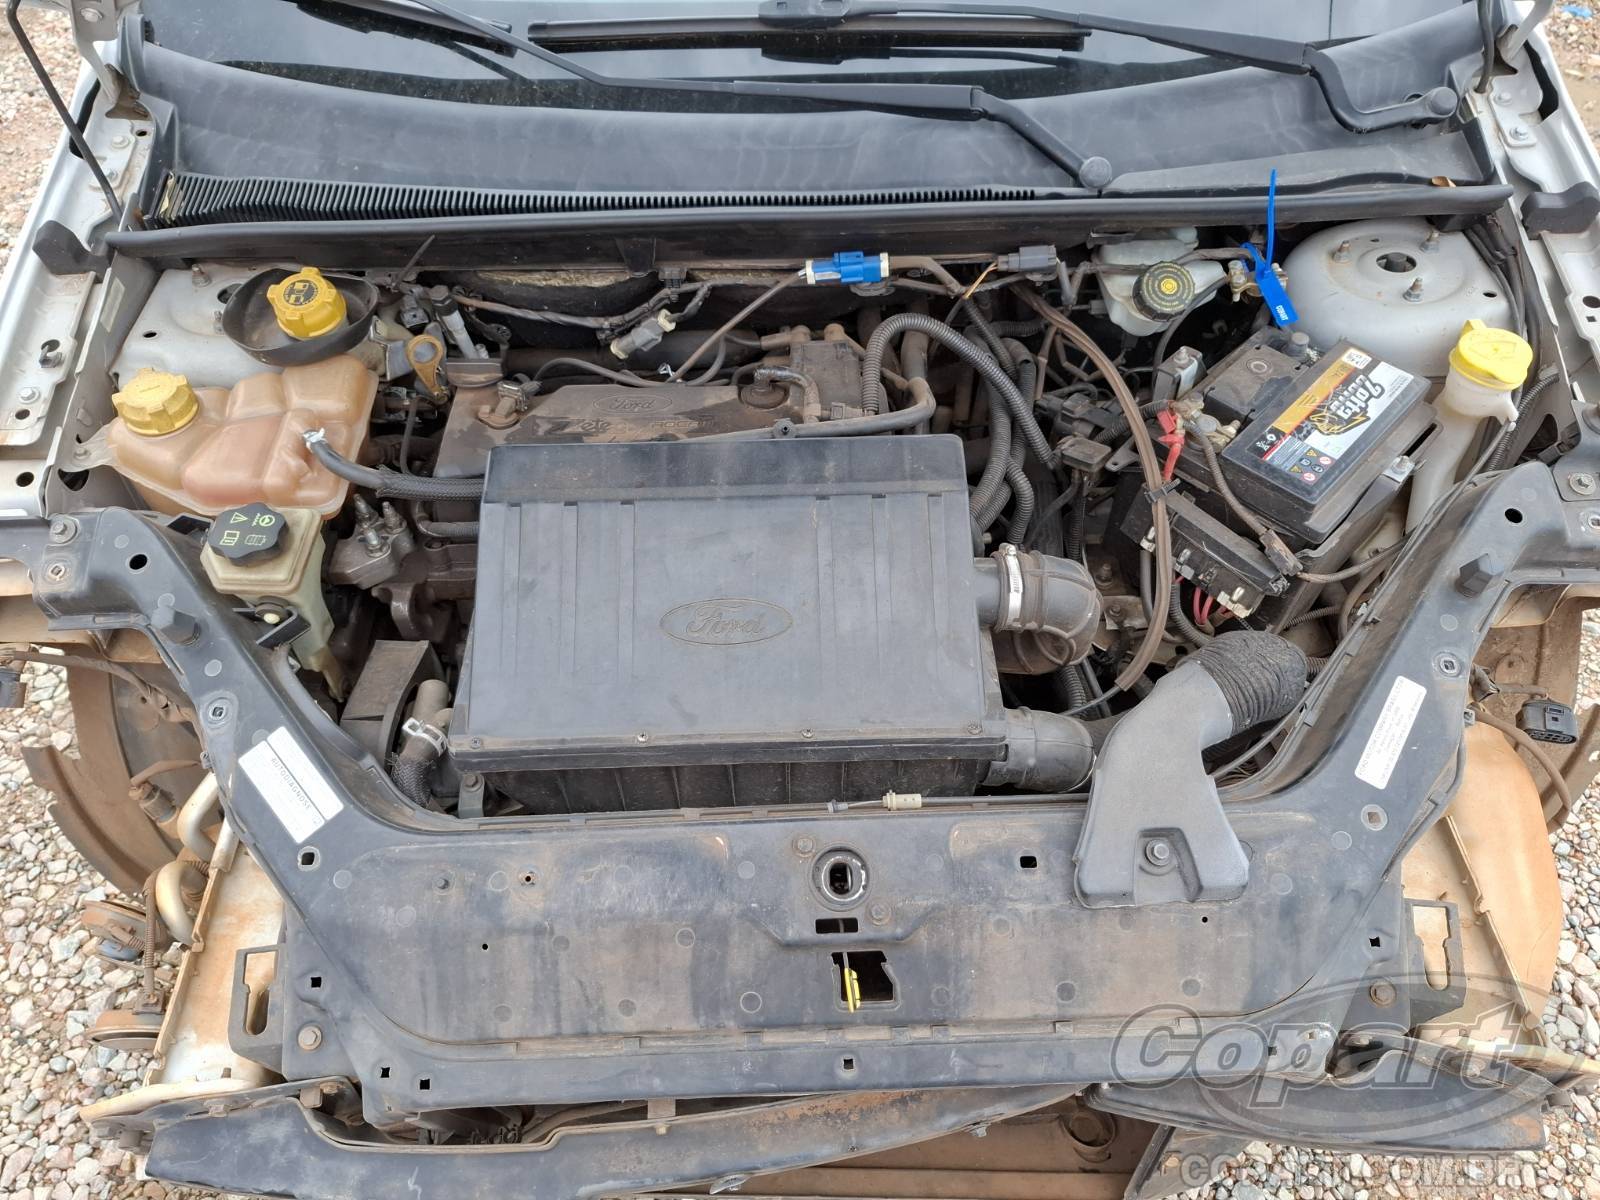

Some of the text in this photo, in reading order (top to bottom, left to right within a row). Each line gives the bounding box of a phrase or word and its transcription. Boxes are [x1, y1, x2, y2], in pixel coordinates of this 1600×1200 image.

[605, 396, 657, 412] Ford
[686, 604, 767, 637] Ford
[270, 757, 312, 810] AUTODIAGNOSE
